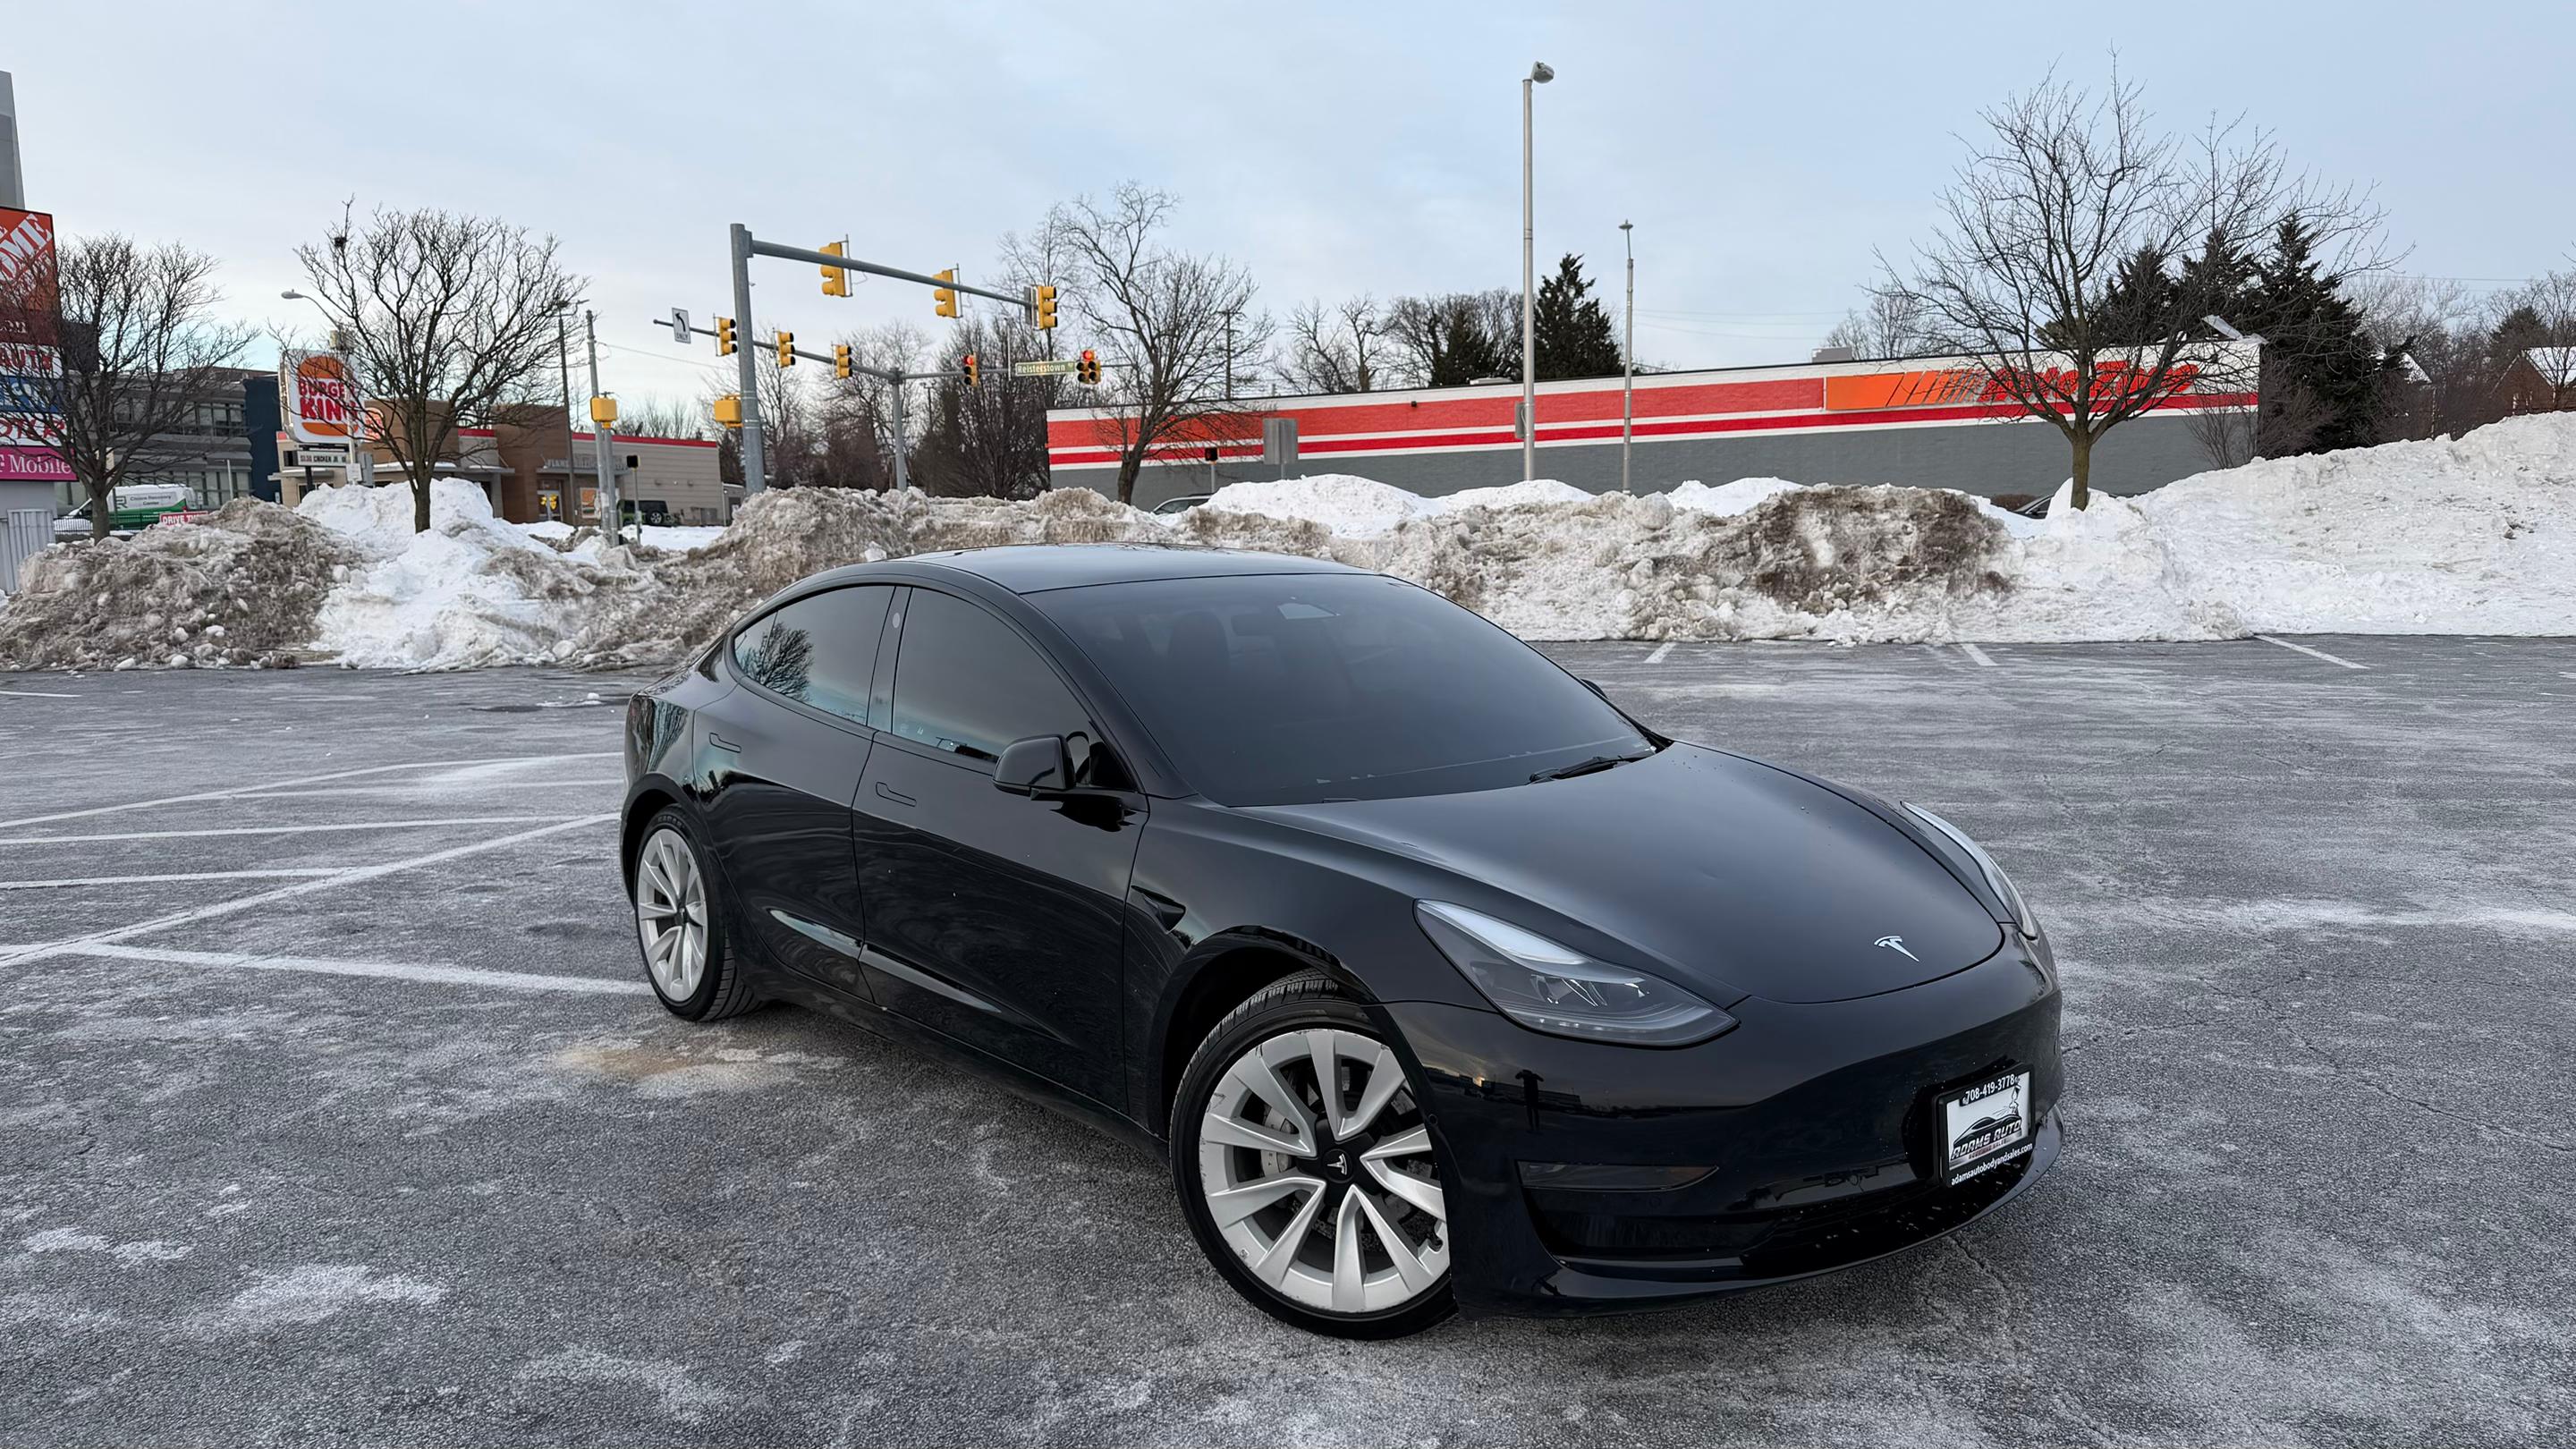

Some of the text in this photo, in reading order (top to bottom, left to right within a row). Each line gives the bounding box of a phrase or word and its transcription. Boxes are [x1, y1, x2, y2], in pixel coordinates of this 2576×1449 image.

[0, 214, 52, 281] OME
[1017, 365, 1065, 373] Reisterstown
[8, 453, 72, 474] Mobile
[162, 514, 184, 526] DRIVE
[1965, 1073, 2015, 1102] 708-419-3778
[1951, 1132, 1991, 1160] ADAMS
[1994, 1119, 2021, 1141] AUTO
